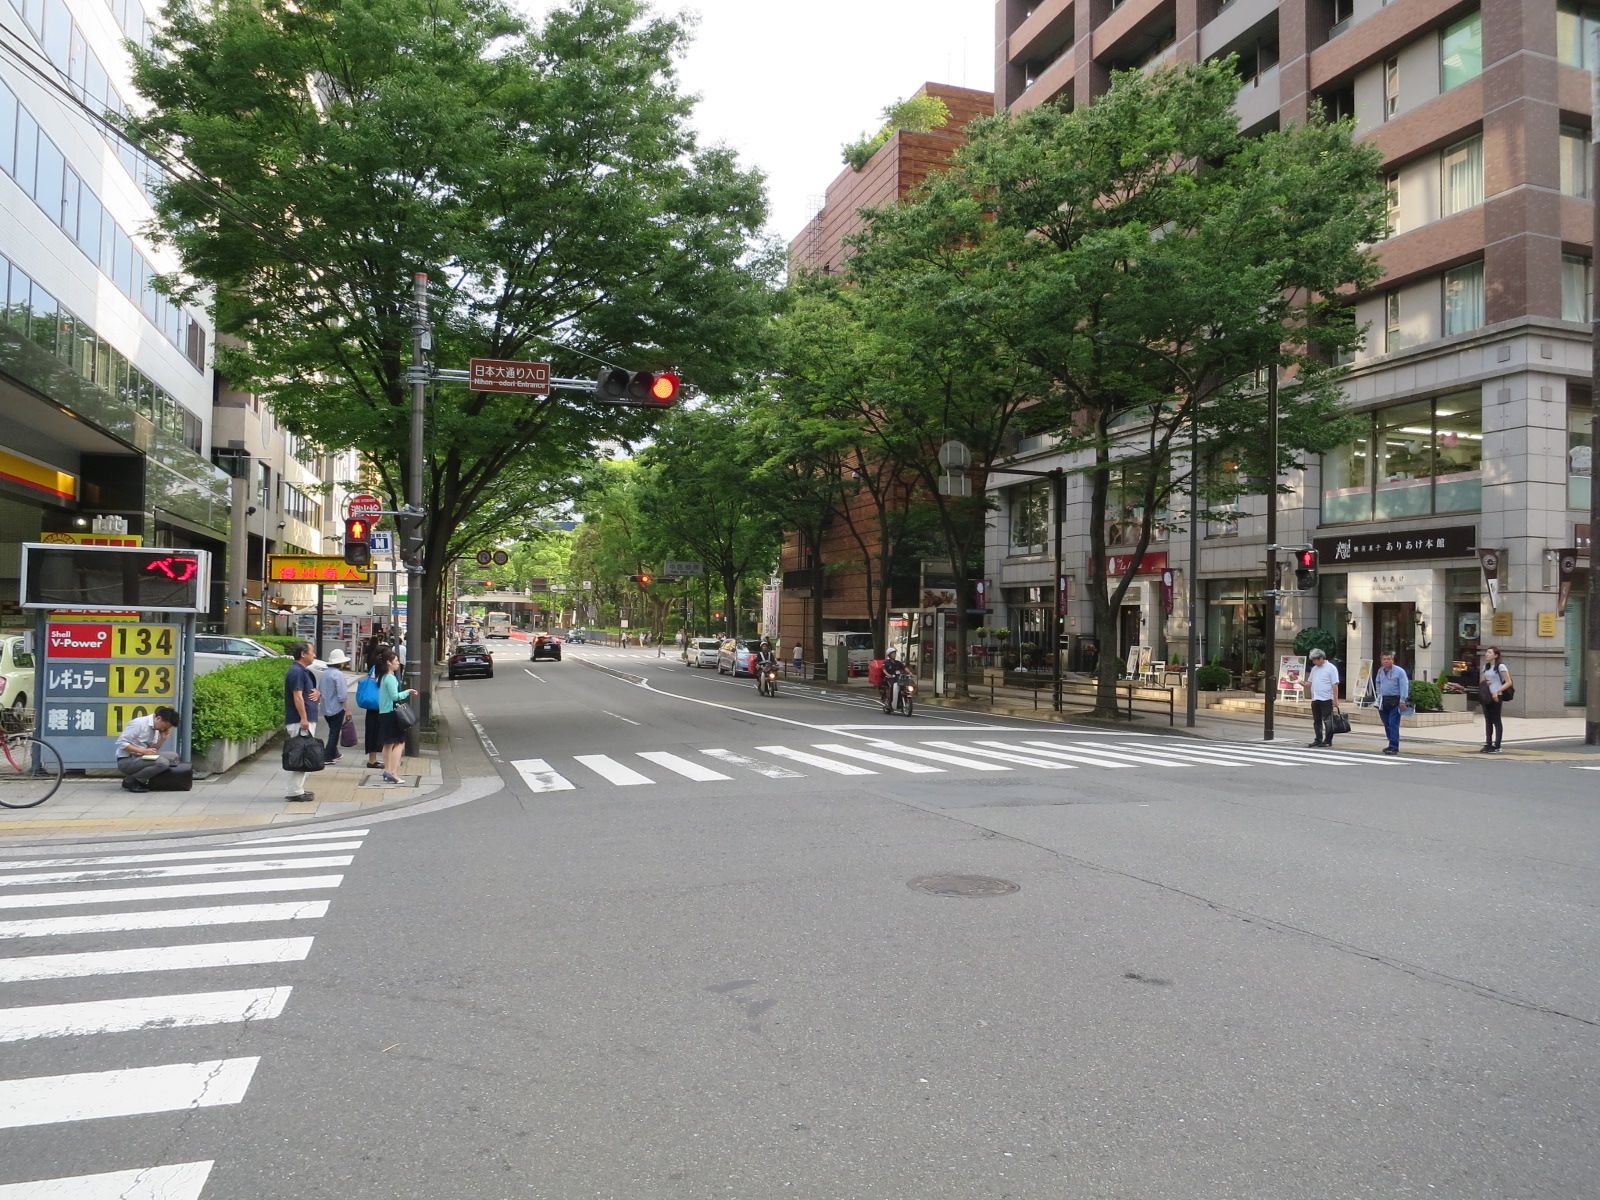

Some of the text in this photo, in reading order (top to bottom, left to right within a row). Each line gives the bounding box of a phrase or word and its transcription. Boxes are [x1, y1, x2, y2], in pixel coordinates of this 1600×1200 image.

[475, 365, 546, 380] 日本大通り入口
[517, 380, 546, 389] Entrance
[1386, 538, 1446, 551] ありあけ本館
[51, 638, 103, 648] V-Power
[117, 628, 172, 655] 134
[49, 669, 107, 690] レギュラー
[115, 667, 171, 694] 123
